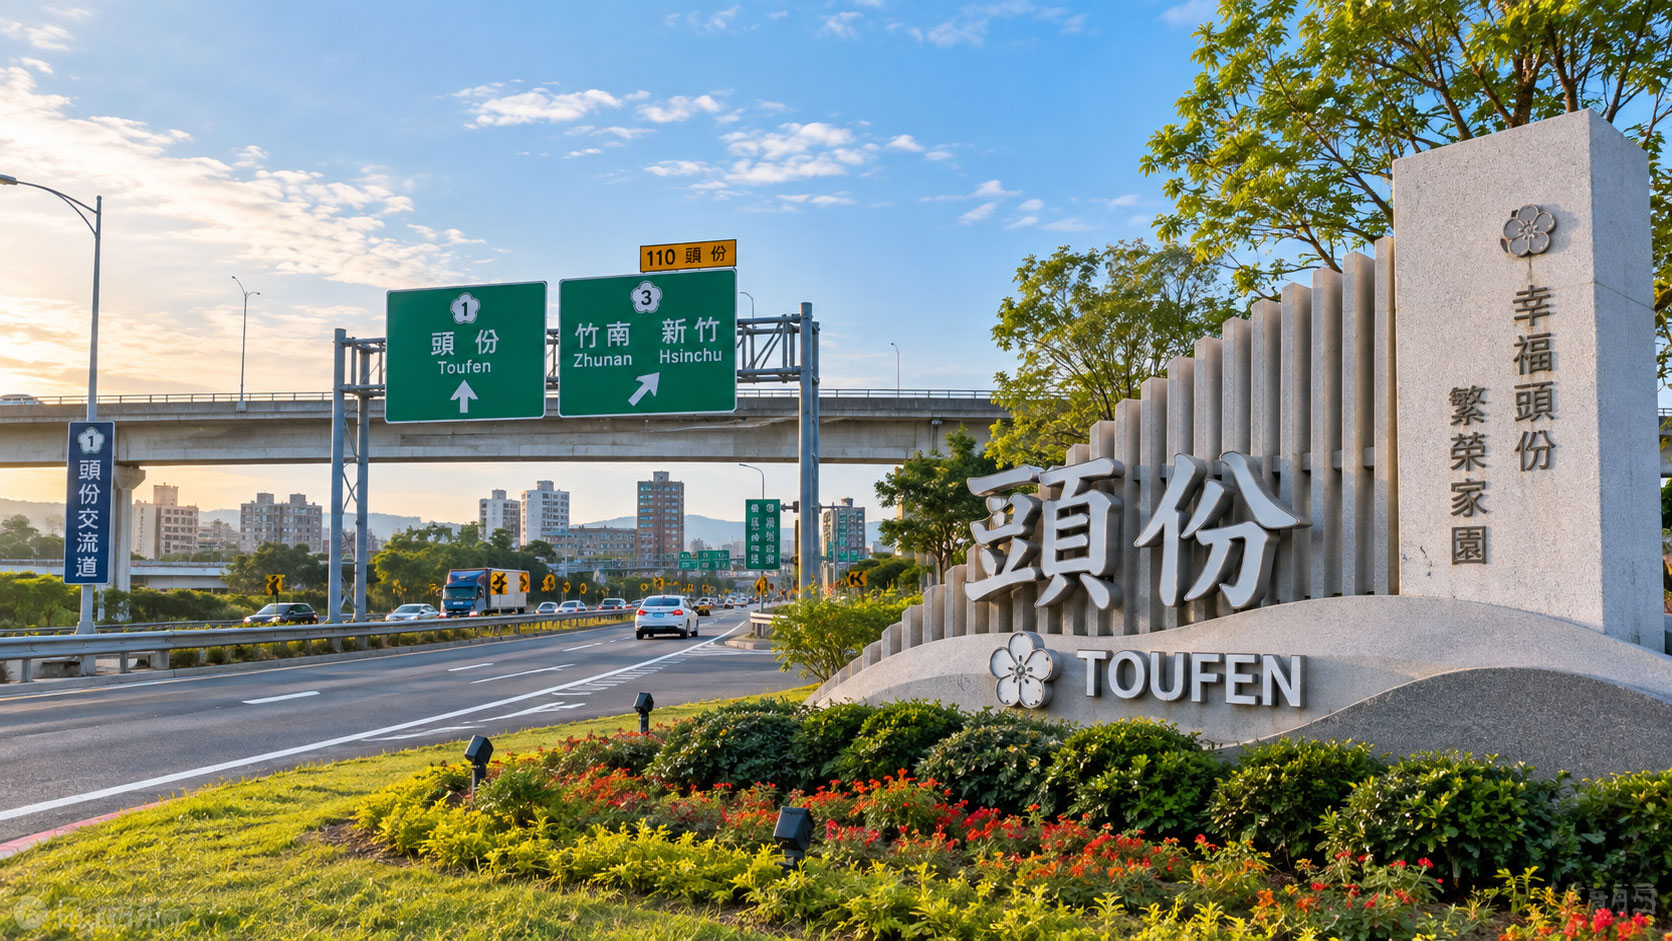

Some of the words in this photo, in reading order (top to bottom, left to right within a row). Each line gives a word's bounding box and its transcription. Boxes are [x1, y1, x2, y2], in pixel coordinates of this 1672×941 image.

[646, 249, 676, 267] 110
[685, 245, 727, 264] 頭份
[461, 301, 468, 317] 1
[641, 290, 652, 306] 3
[430, 329, 500, 356] 頭份
[574, 321, 631, 349] 竹南
[661, 316, 721, 345] 新竹
[437, 359, 492, 375] Toufen
[573, 353, 633, 368] Zhunan
[659, 348, 723, 364] Hsinchu
[1513, 285, 1556, 472] 幸福頭份
[87, 435, 94, 448] 1
[75, 459, 101, 578] 頭份交流道
[963, 450, 1311, 610] 頭份
[1076, 648, 1306, 708] TOUFEN
